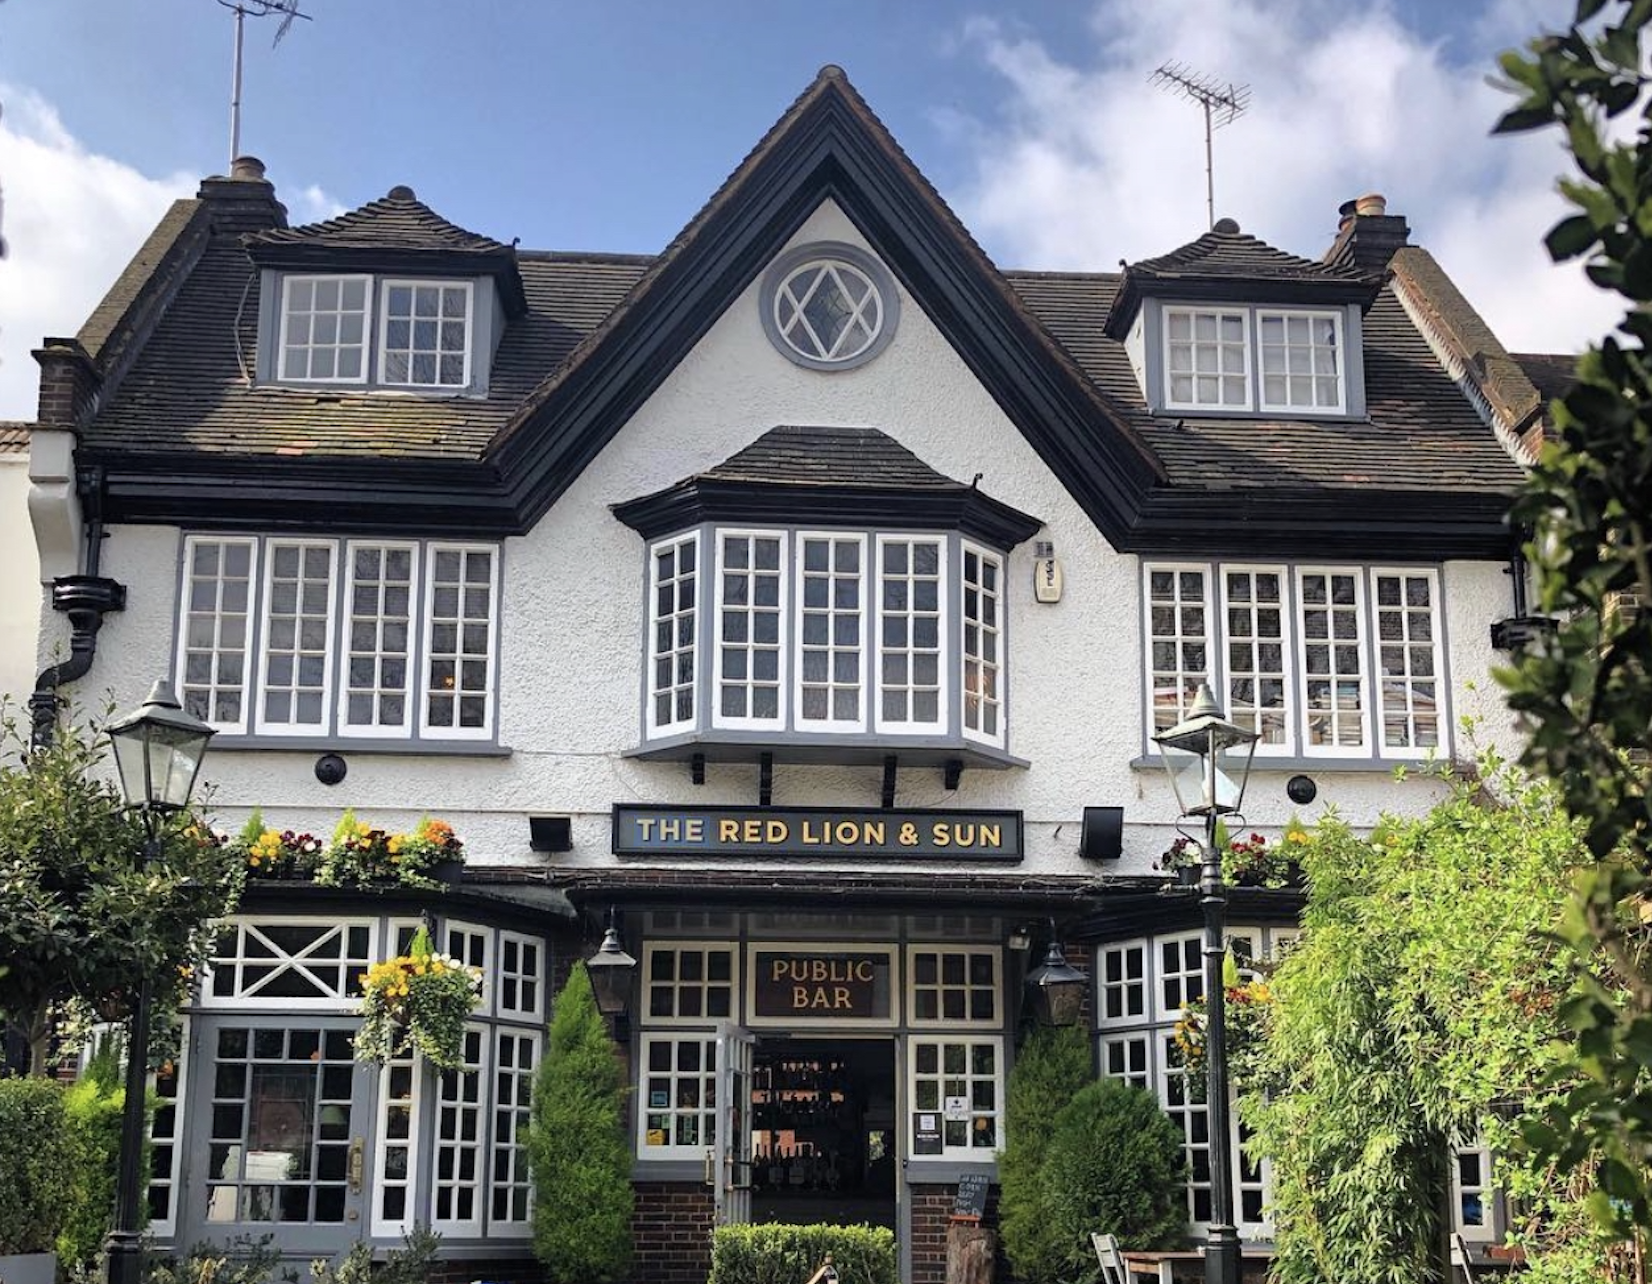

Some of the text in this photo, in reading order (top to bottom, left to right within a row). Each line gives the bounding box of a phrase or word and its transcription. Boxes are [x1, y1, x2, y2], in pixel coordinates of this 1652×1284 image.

[636, 818, 1001, 847] THE RED LION & SUN
[772, 959, 874, 982] PUBLIC
[792, 985, 853, 1009] BAR
